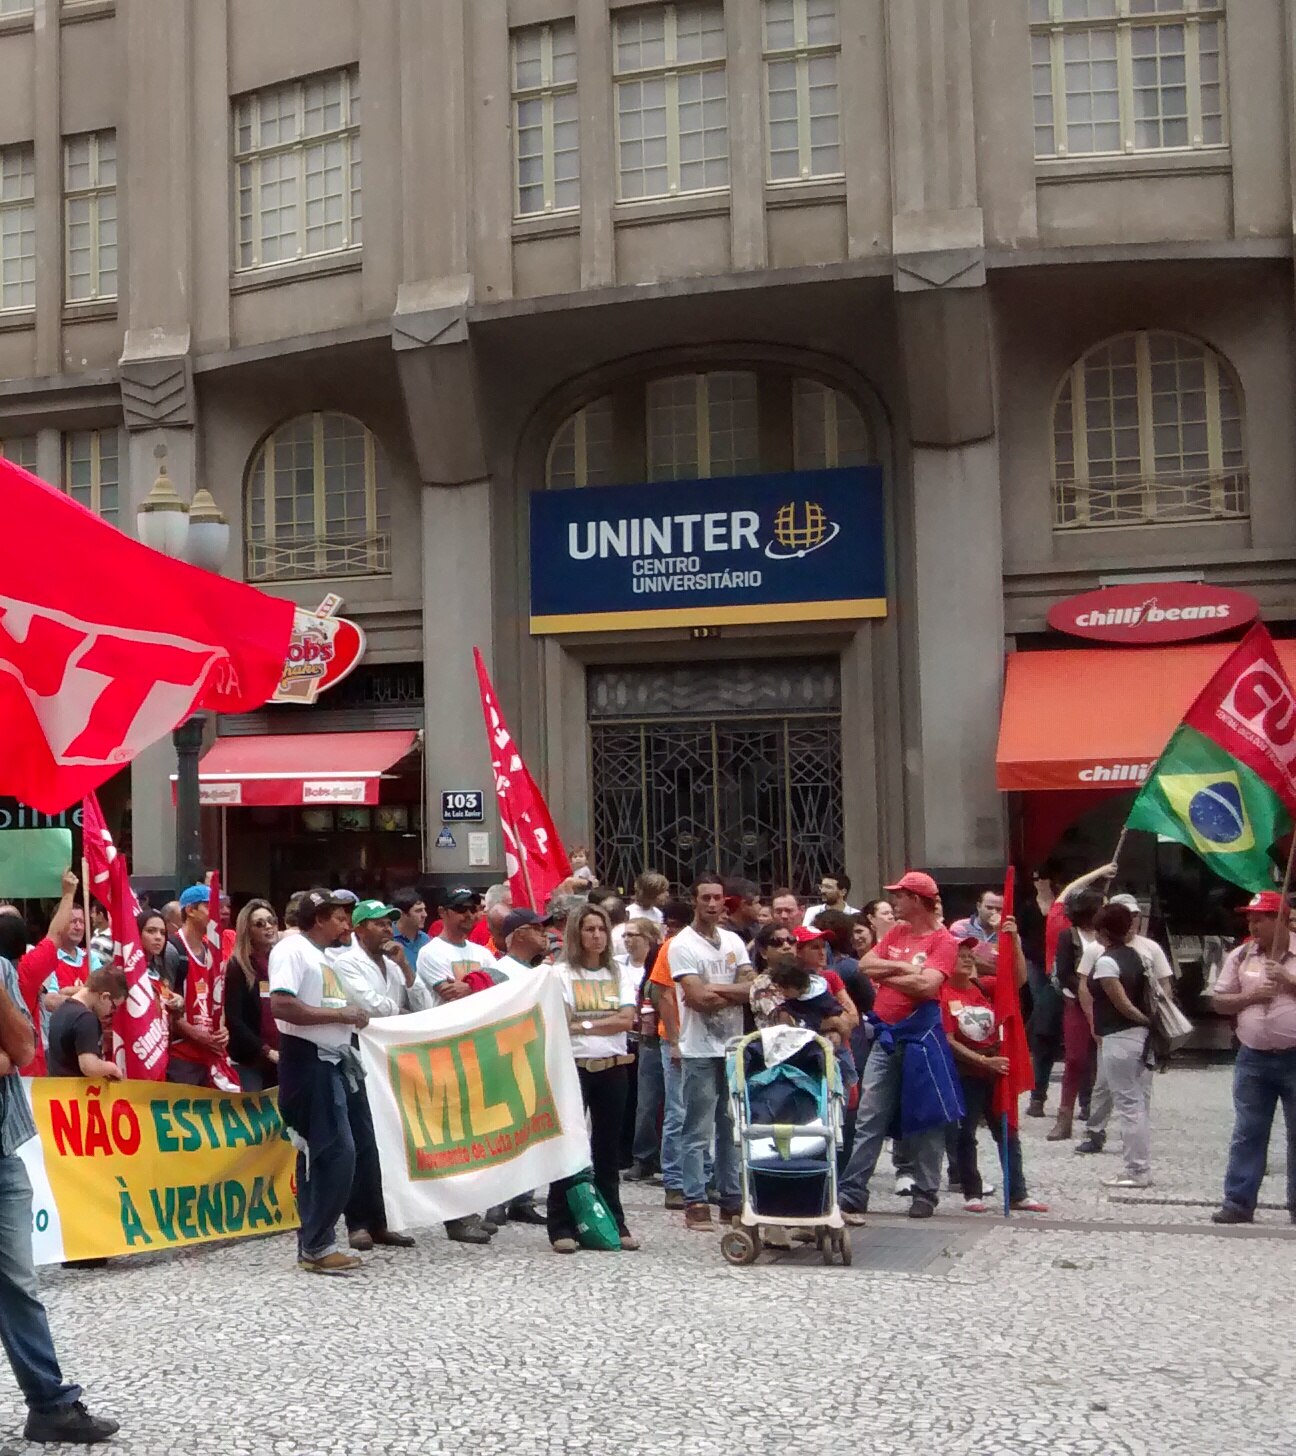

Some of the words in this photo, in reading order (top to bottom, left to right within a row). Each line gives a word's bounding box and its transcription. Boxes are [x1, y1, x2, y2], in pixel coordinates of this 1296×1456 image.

[568, 511, 760, 560] UNINTER
[633, 556, 700, 576] CENTRO
[633, 568, 762, 593] UNIVERSITÁRIO
[1076, 607, 1142, 627] chilli
[1147, 604, 1231, 621] beans
[288, 637, 334, 662] ob's
[1220, 658, 1296, 795] CU
[446, 794, 478, 808] 103
[397, 1017, 538, 1148] MLT
[50, 1085, 142, 1157] NÃO
[150, 1095, 292, 1153] ESTAM
[115, 1176, 153, 1246] À
[149, 1175, 283, 1242] VENDA!
